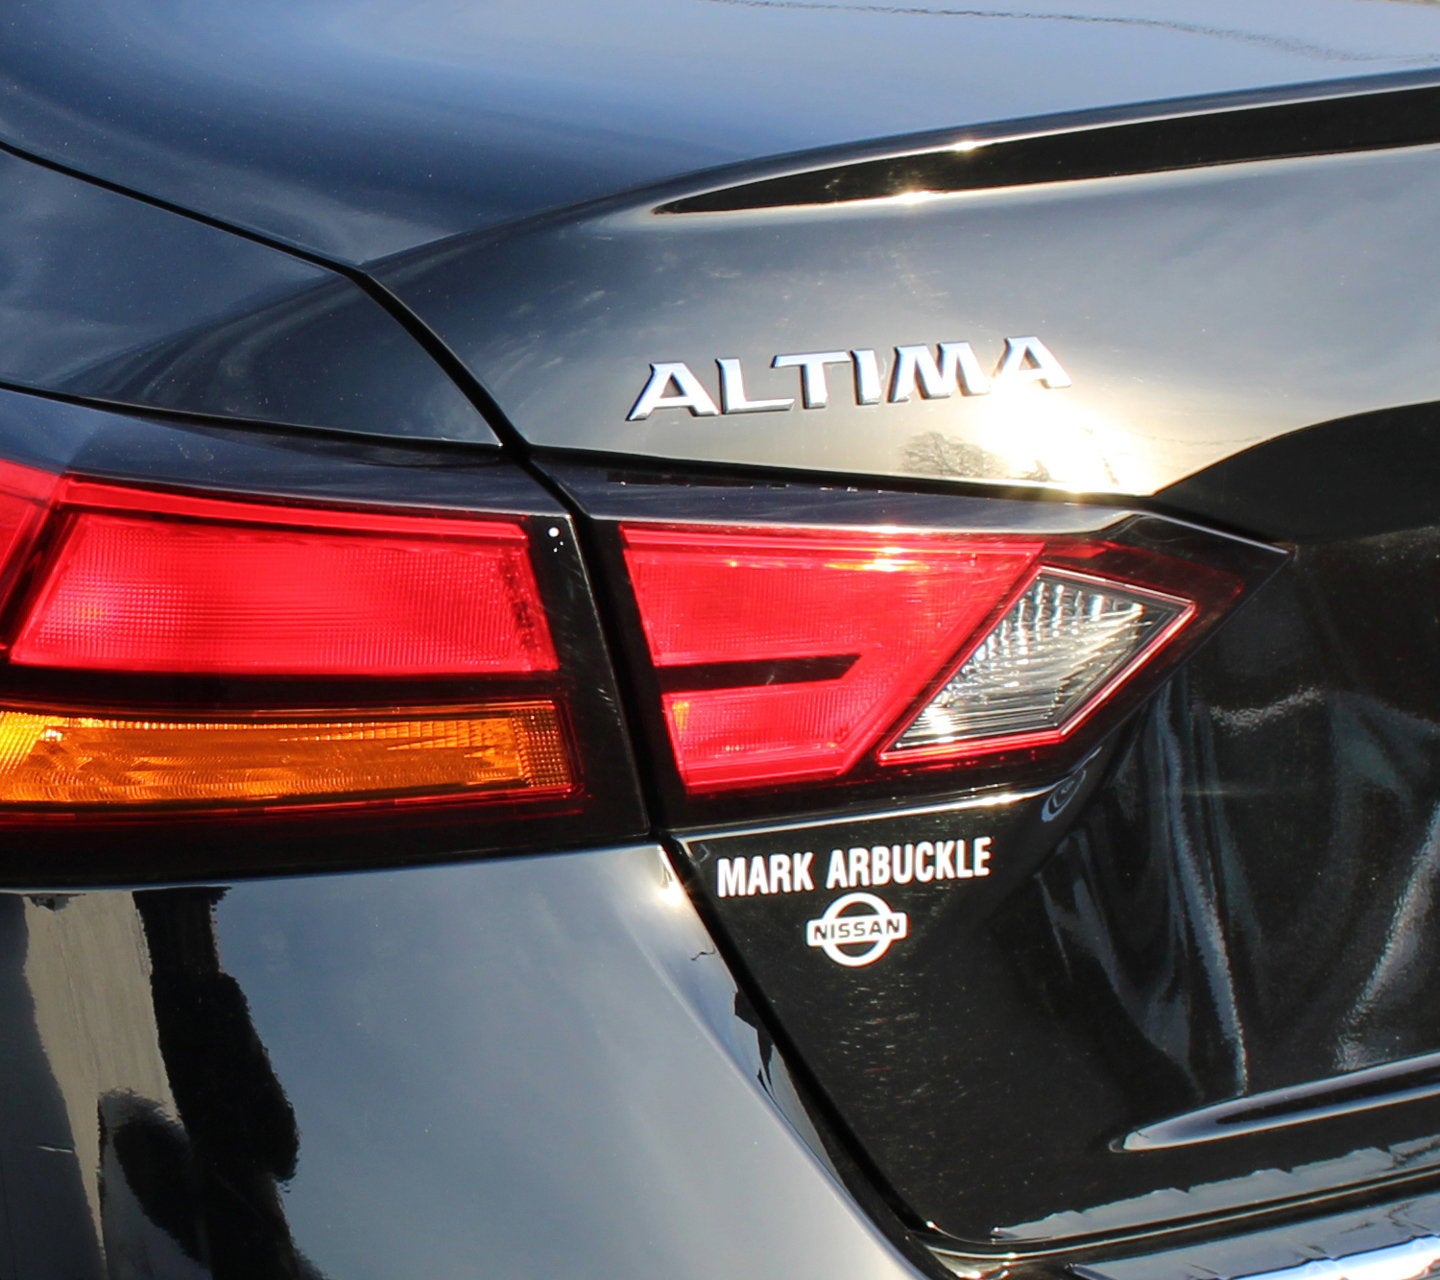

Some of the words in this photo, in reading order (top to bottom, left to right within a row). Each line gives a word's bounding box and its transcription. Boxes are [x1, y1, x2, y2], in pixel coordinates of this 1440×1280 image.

[624, 335, 1072, 421] ALTIMA
[717, 851, 815, 898] MARK
[825, 836, 992, 890] ARBUCKLE
[814, 918, 901, 941] NISSAN
